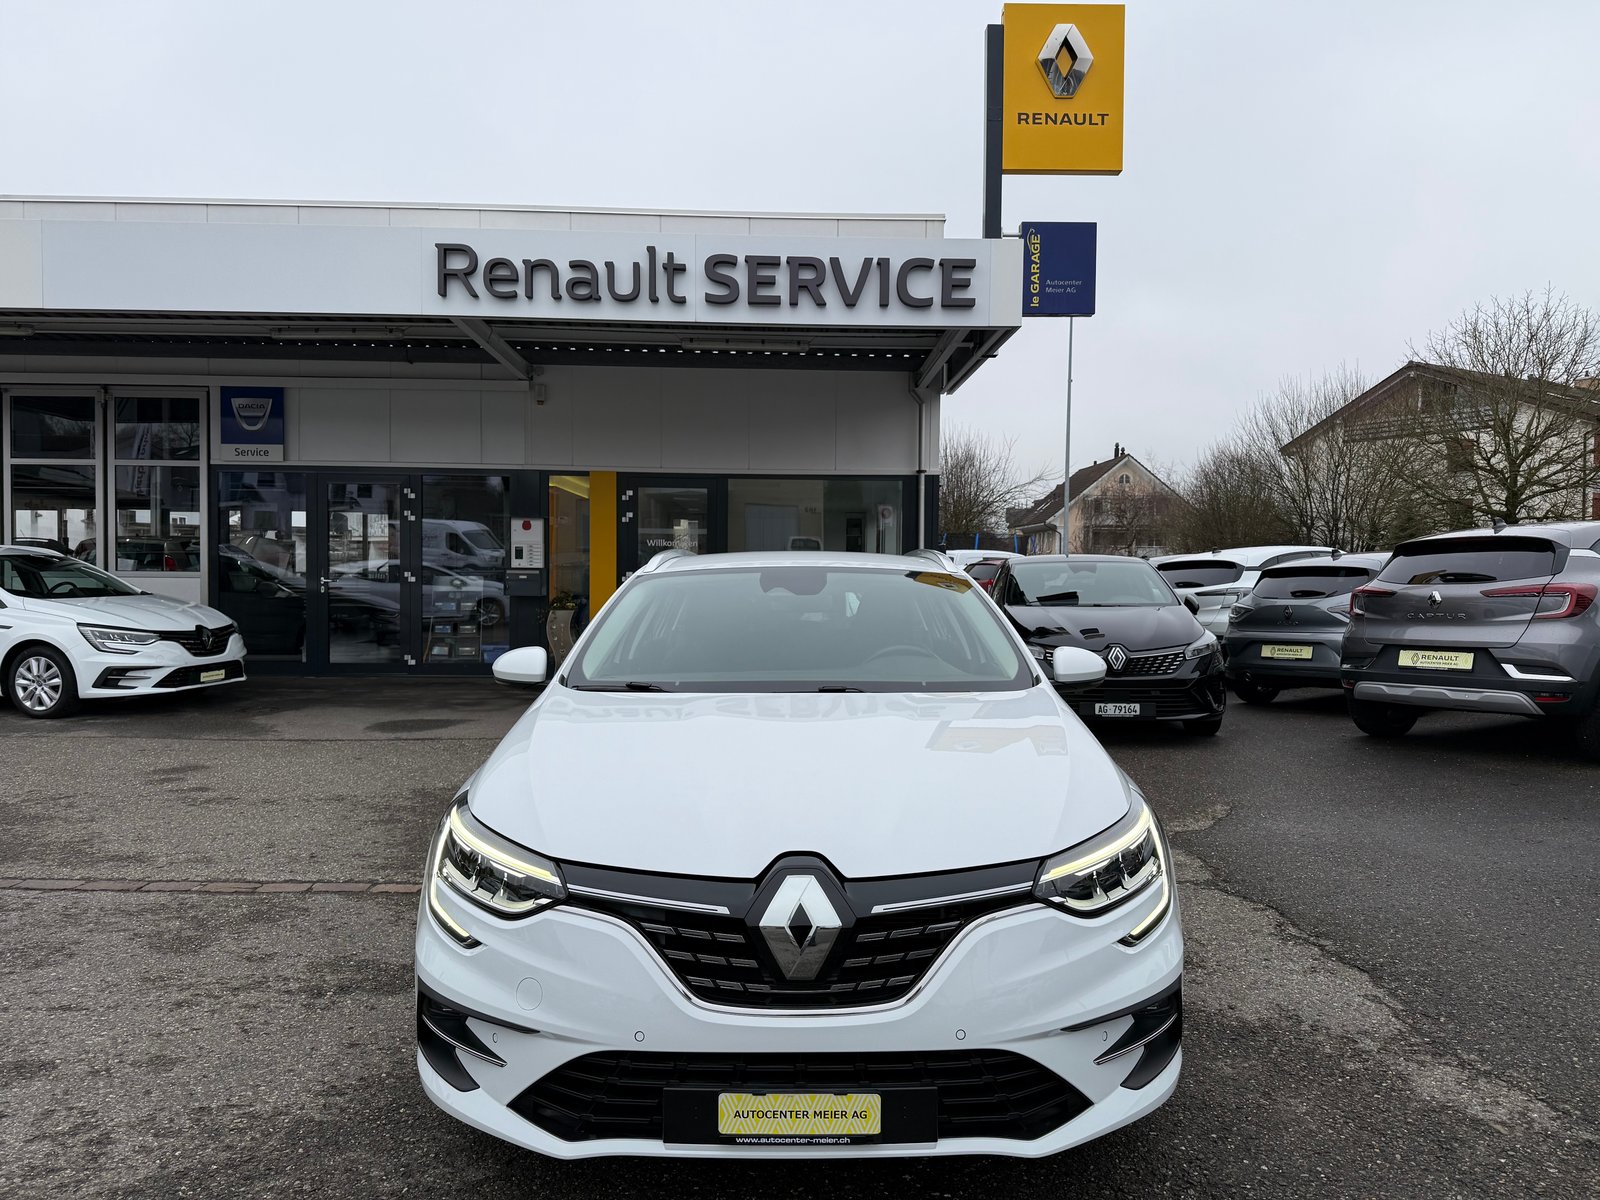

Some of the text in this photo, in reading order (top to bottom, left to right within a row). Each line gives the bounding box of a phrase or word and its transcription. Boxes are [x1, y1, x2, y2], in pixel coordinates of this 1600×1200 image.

[1017, 112, 1109, 126] RENAULT
[434, 243, 977, 308] Renault SERVICE
[1030, 234, 1041, 307] le GARAGE
[234, 447, 270, 457] Service
[1421, 654, 1460, 662] RENAULT
[733, 1110, 868, 1119] AUTOCENTER MEIER AG
[735, 1136, 851, 1144] www.autocenter-meier.ch
